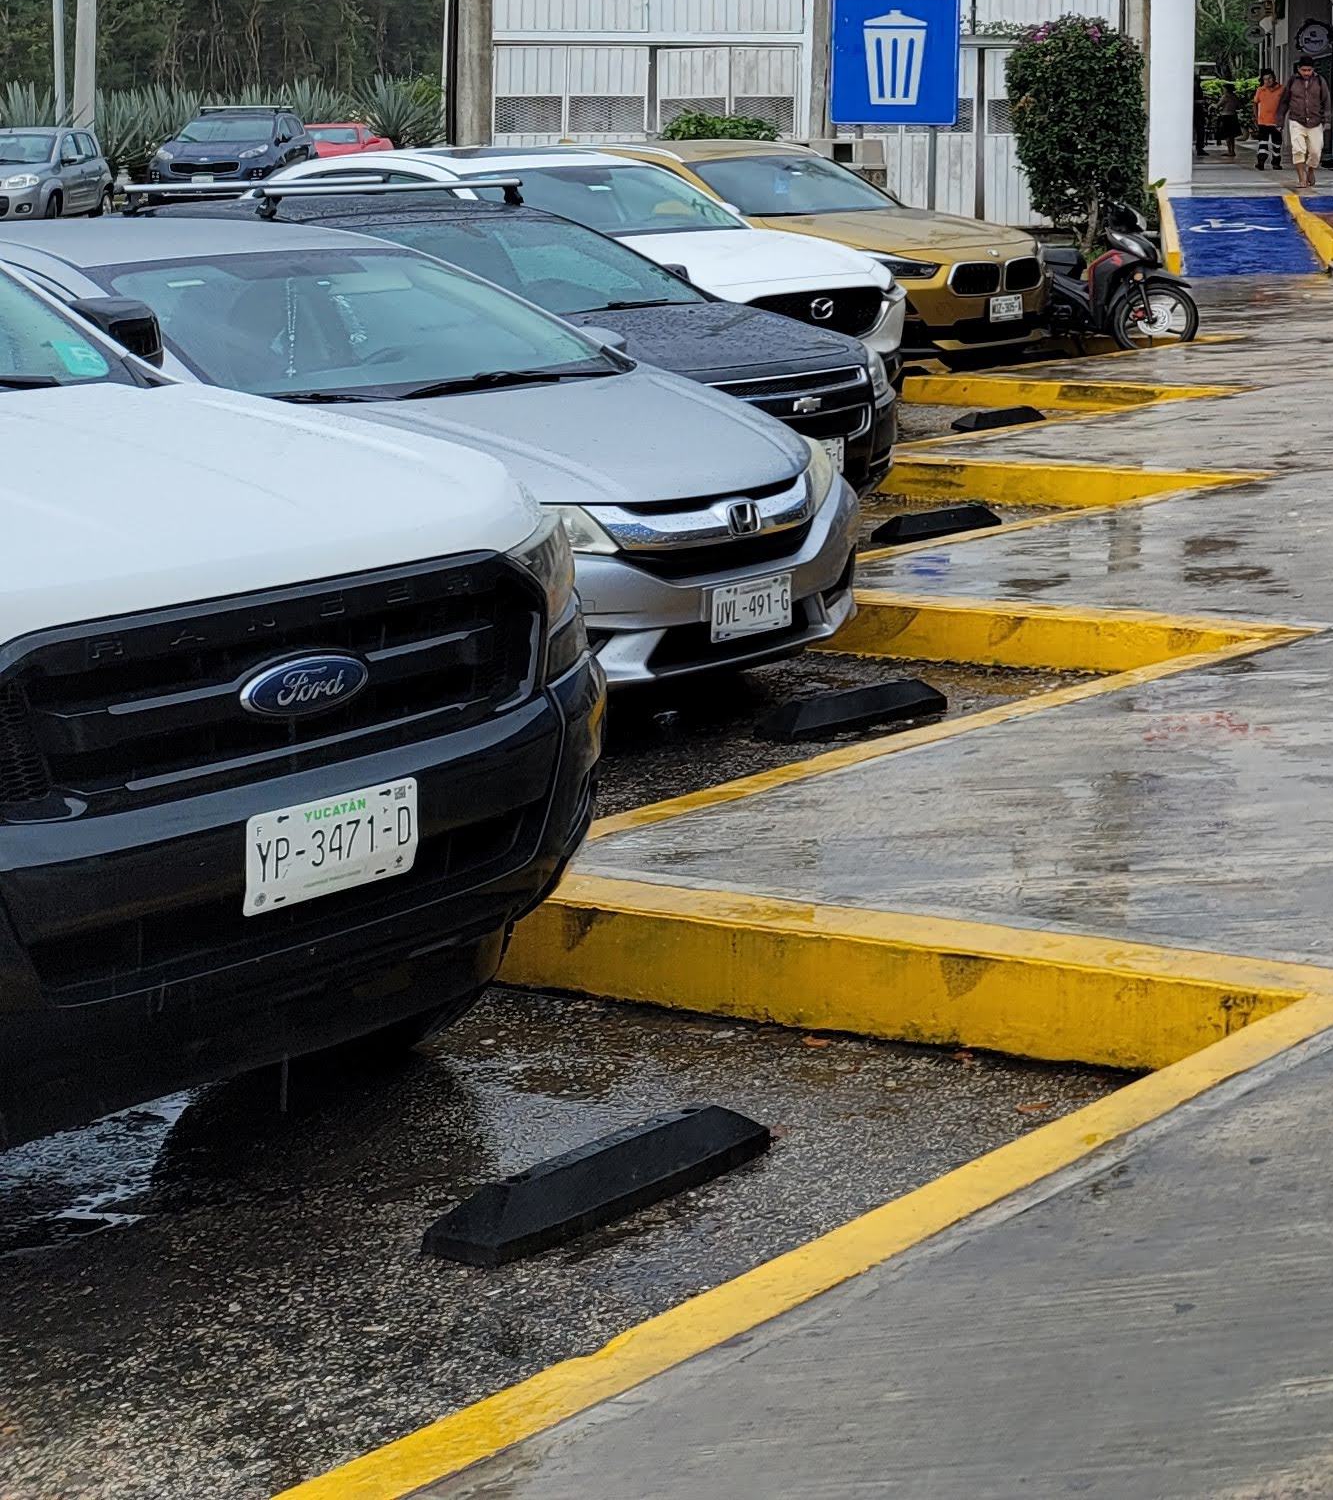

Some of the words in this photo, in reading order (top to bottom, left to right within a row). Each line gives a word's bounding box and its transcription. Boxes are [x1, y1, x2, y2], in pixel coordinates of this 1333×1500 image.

[277, 665, 345, 706] Ford
[304, 798, 366, 822] YUCATÁN
[256, 805, 412, 883] YP-3471-D
